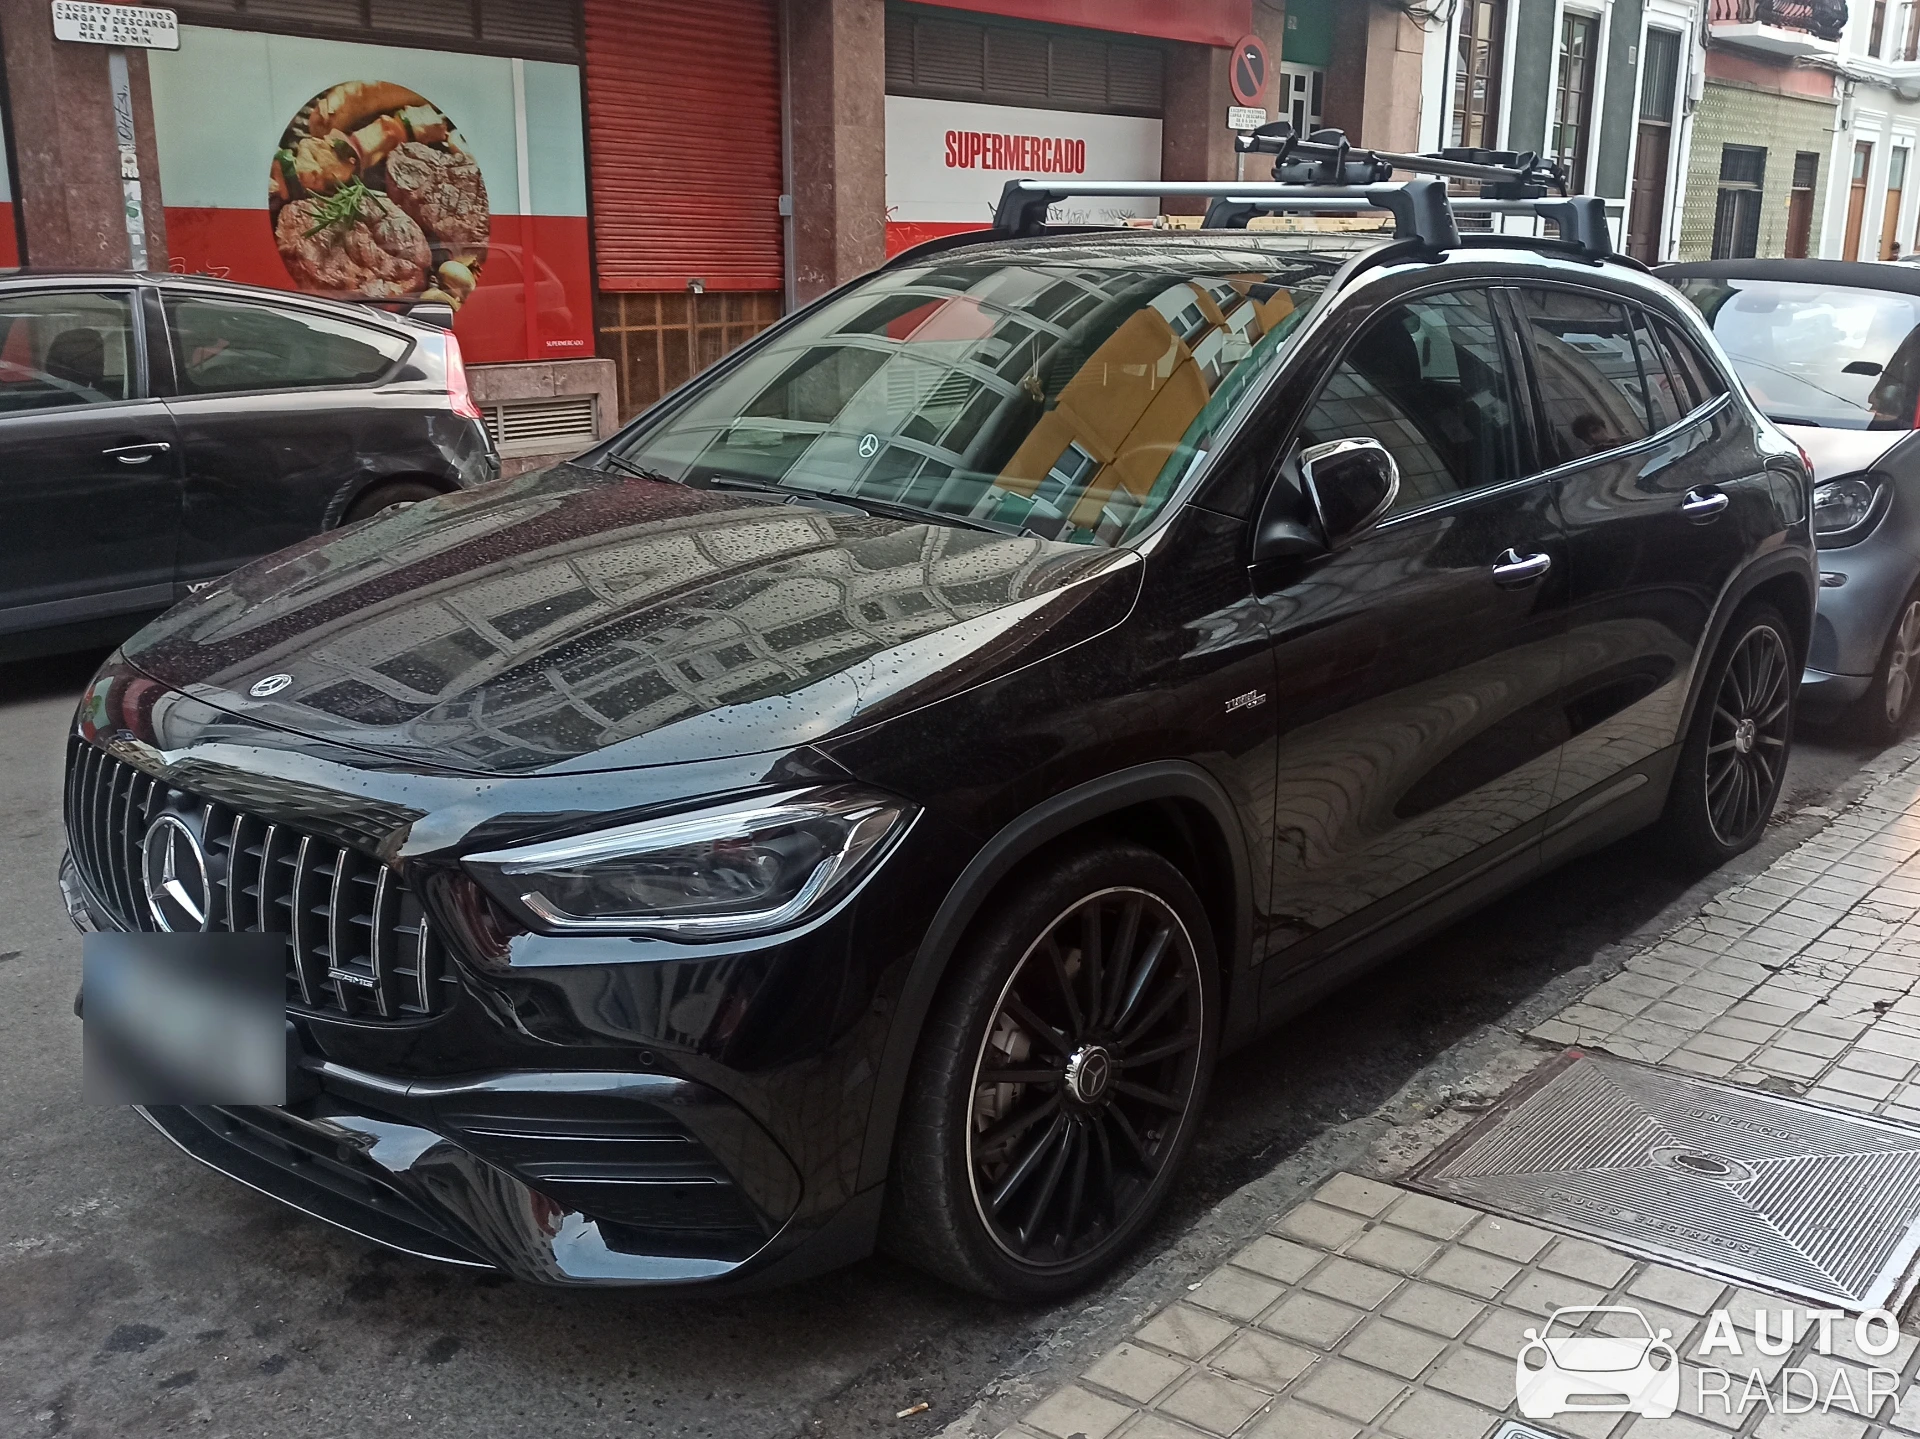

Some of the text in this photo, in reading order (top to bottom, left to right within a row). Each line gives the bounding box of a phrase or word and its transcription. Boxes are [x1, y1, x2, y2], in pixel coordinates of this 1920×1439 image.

[55, 11, 97, 23] CARGA
[112, 16, 175, 29] DESCARGA
[56, 3, 171, 21] EXCEPTO FESTIVOS
[80, 23, 95, 31] DE
[113, 34, 127, 42] 20
[945, 130, 1085, 174] SUPERMERCADO
[1691, 1110, 1790, 1139] UNELCO
